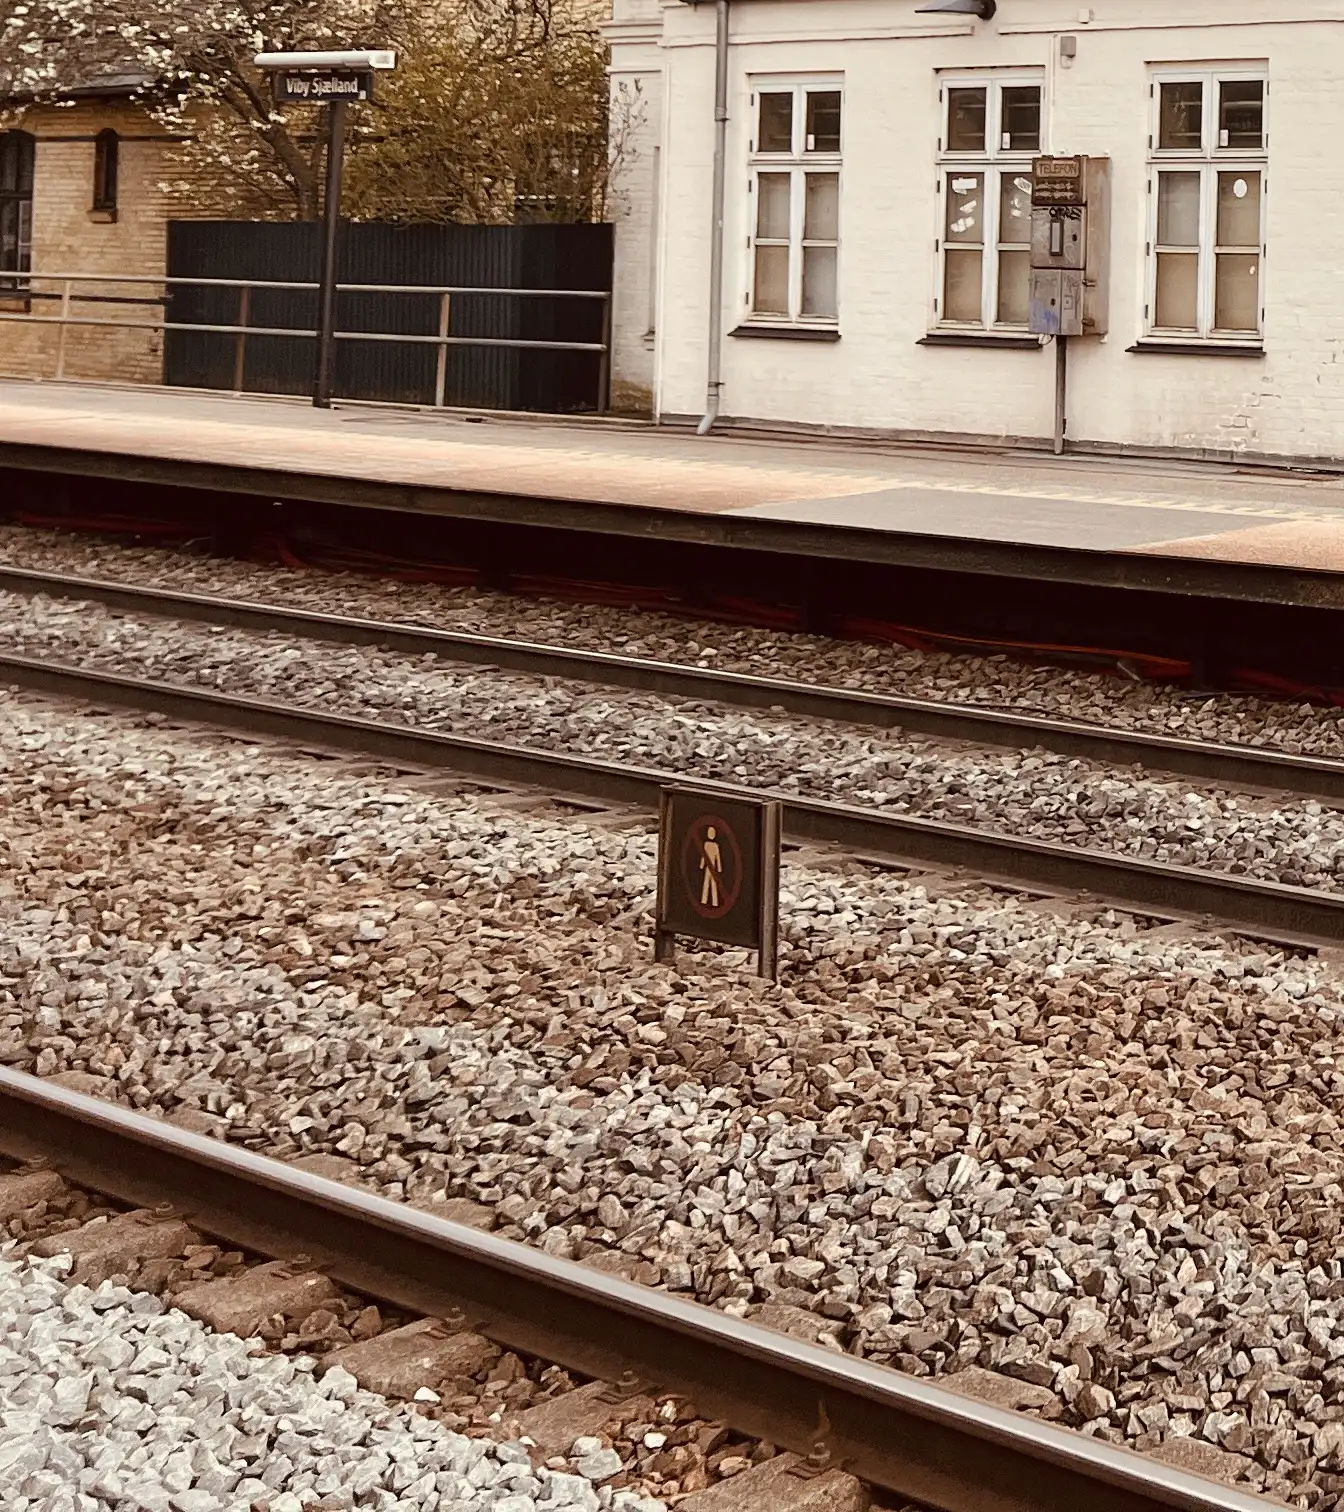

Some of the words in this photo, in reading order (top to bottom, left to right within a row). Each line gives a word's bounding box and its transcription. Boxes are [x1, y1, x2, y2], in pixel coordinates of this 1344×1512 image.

[286, 78, 310, 97] Viby
[312, 77, 358, 96] Sjælland
[1039, 163, 1077, 175] TELEFON
